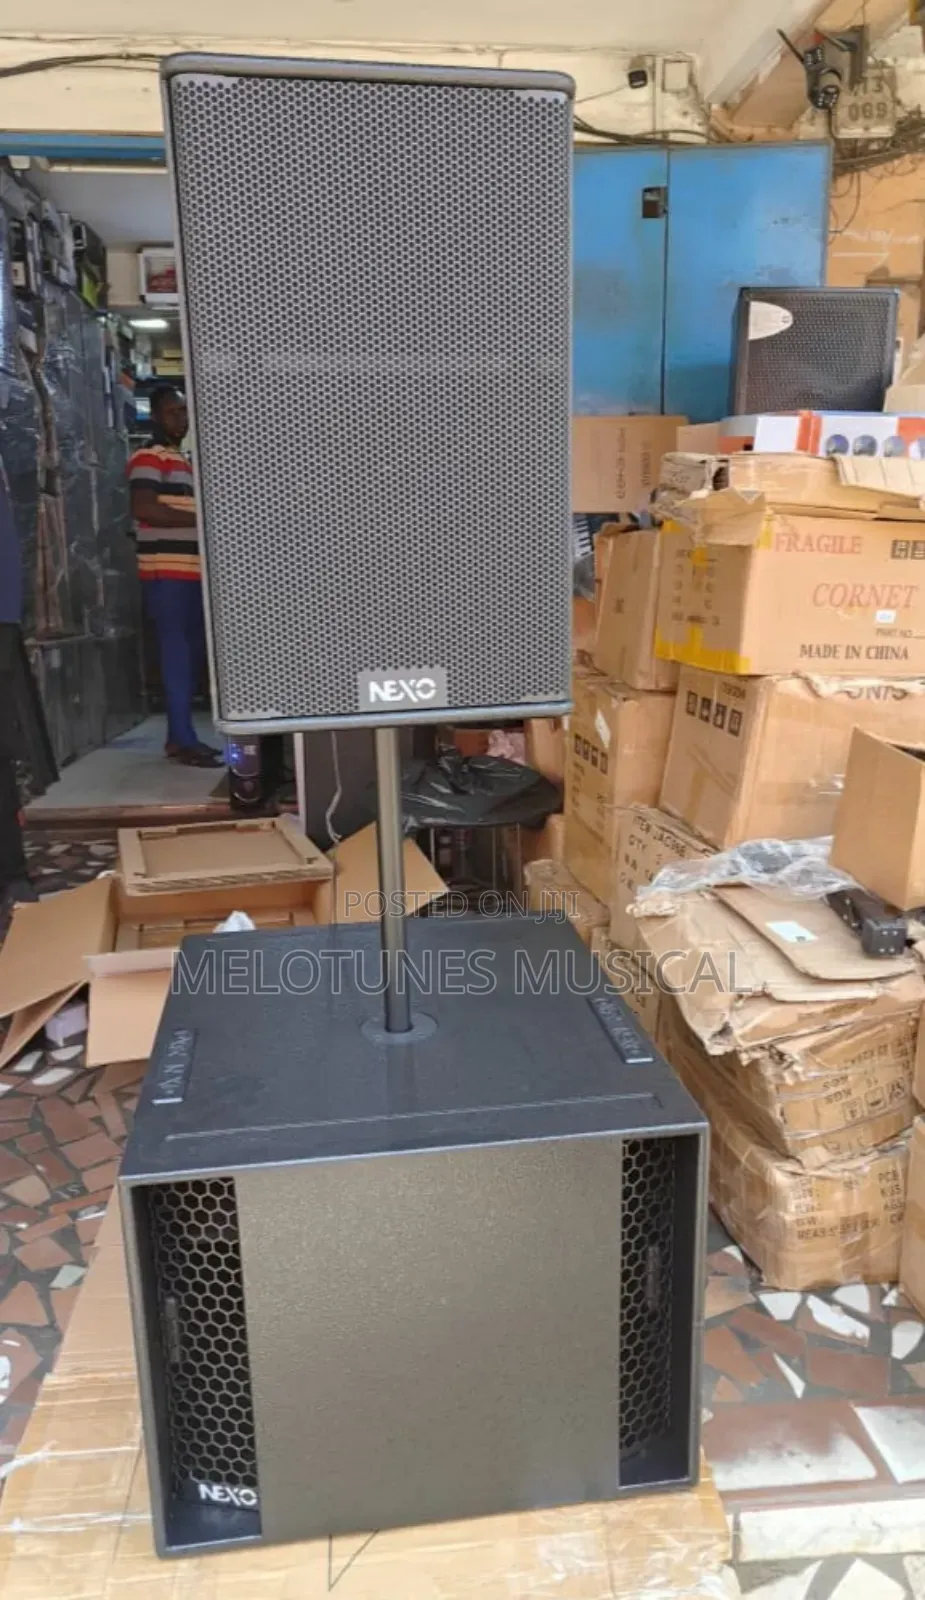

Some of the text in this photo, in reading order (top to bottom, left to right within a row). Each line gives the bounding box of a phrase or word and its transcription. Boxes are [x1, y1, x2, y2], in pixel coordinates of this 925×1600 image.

[775, 532, 864, 554] FRAGILE
[812, 582, 919, 609] CORNET
[800, 644, 908, 660] MADE IN CHINA
[369, 677, 437, 703] NEXO
[199, 1484, 257, 1506] NEXO
